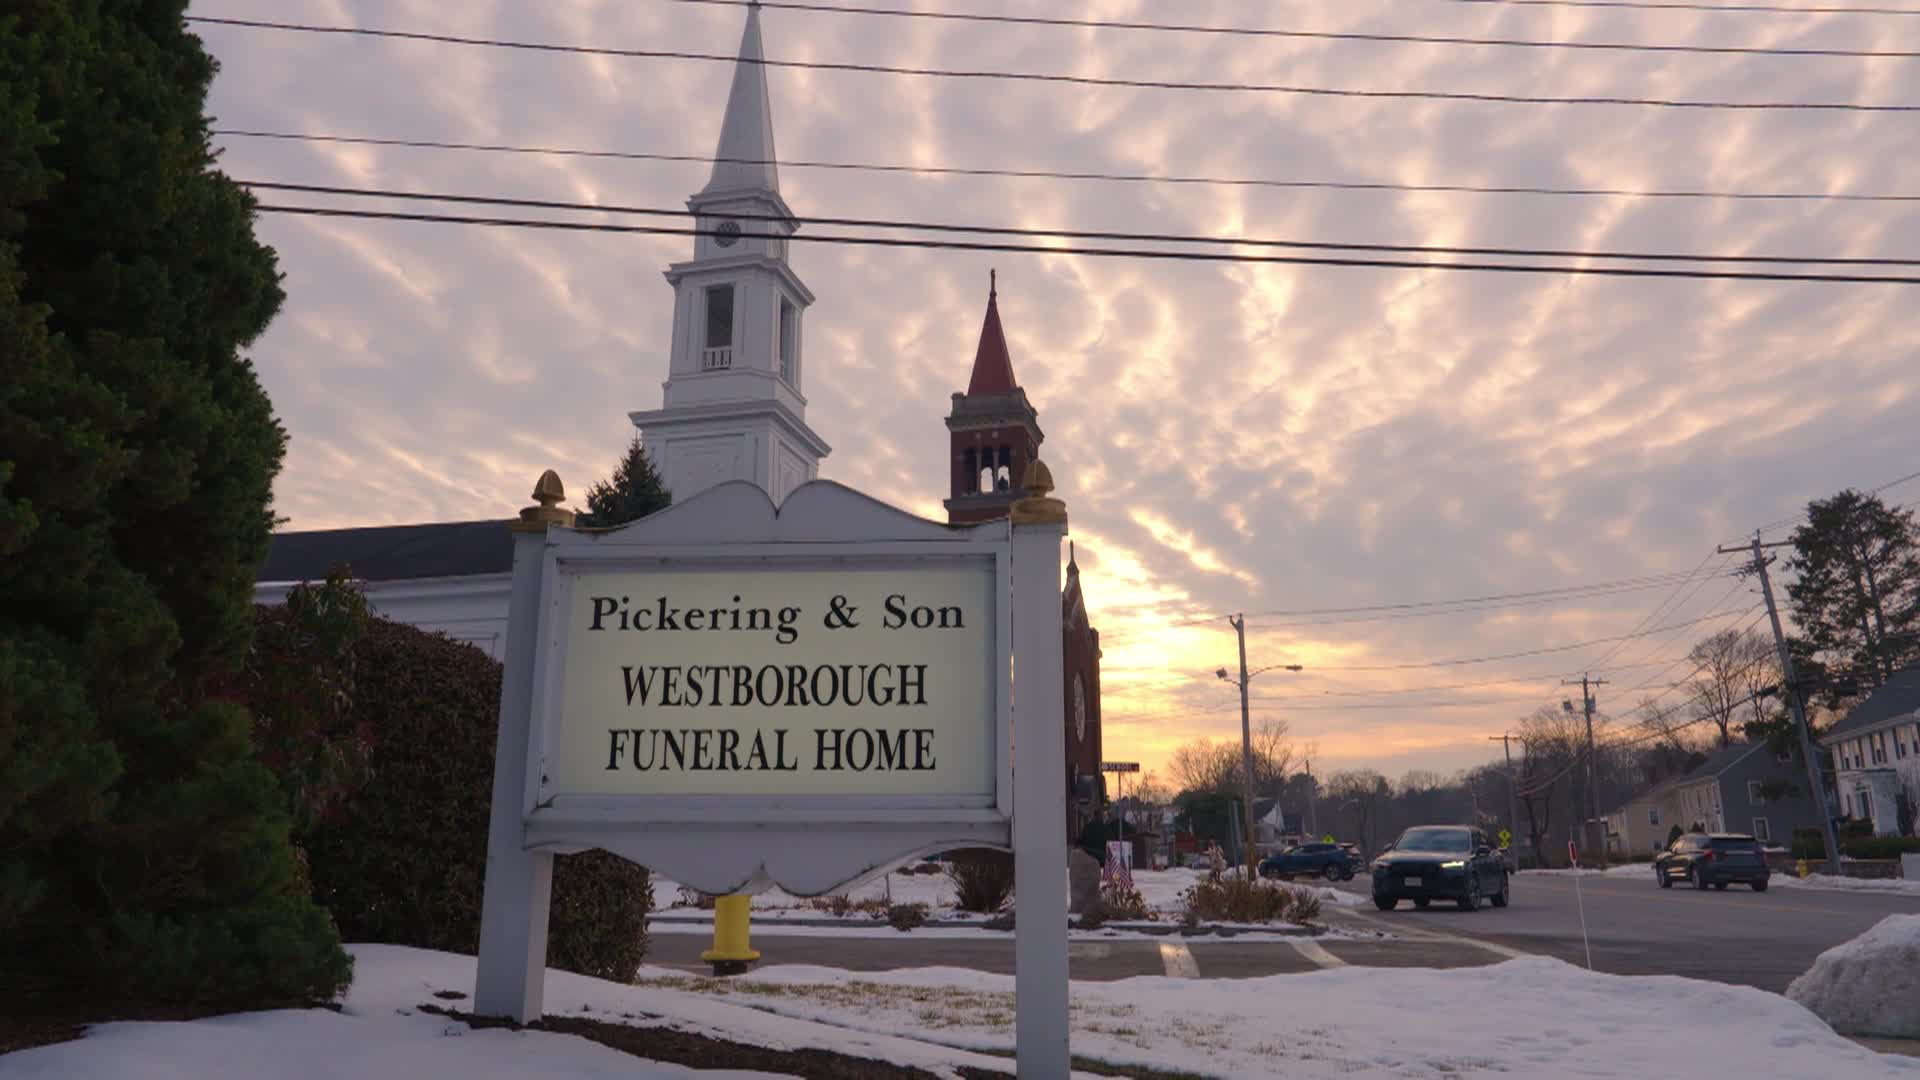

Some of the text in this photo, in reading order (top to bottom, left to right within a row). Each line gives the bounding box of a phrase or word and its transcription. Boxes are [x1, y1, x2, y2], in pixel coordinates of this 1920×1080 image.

[588, 595, 966, 645] Pickering & Son
[621, 663, 928, 707] WESTBOROUGH
[605, 728, 937, 772] FUNERAL HOME
